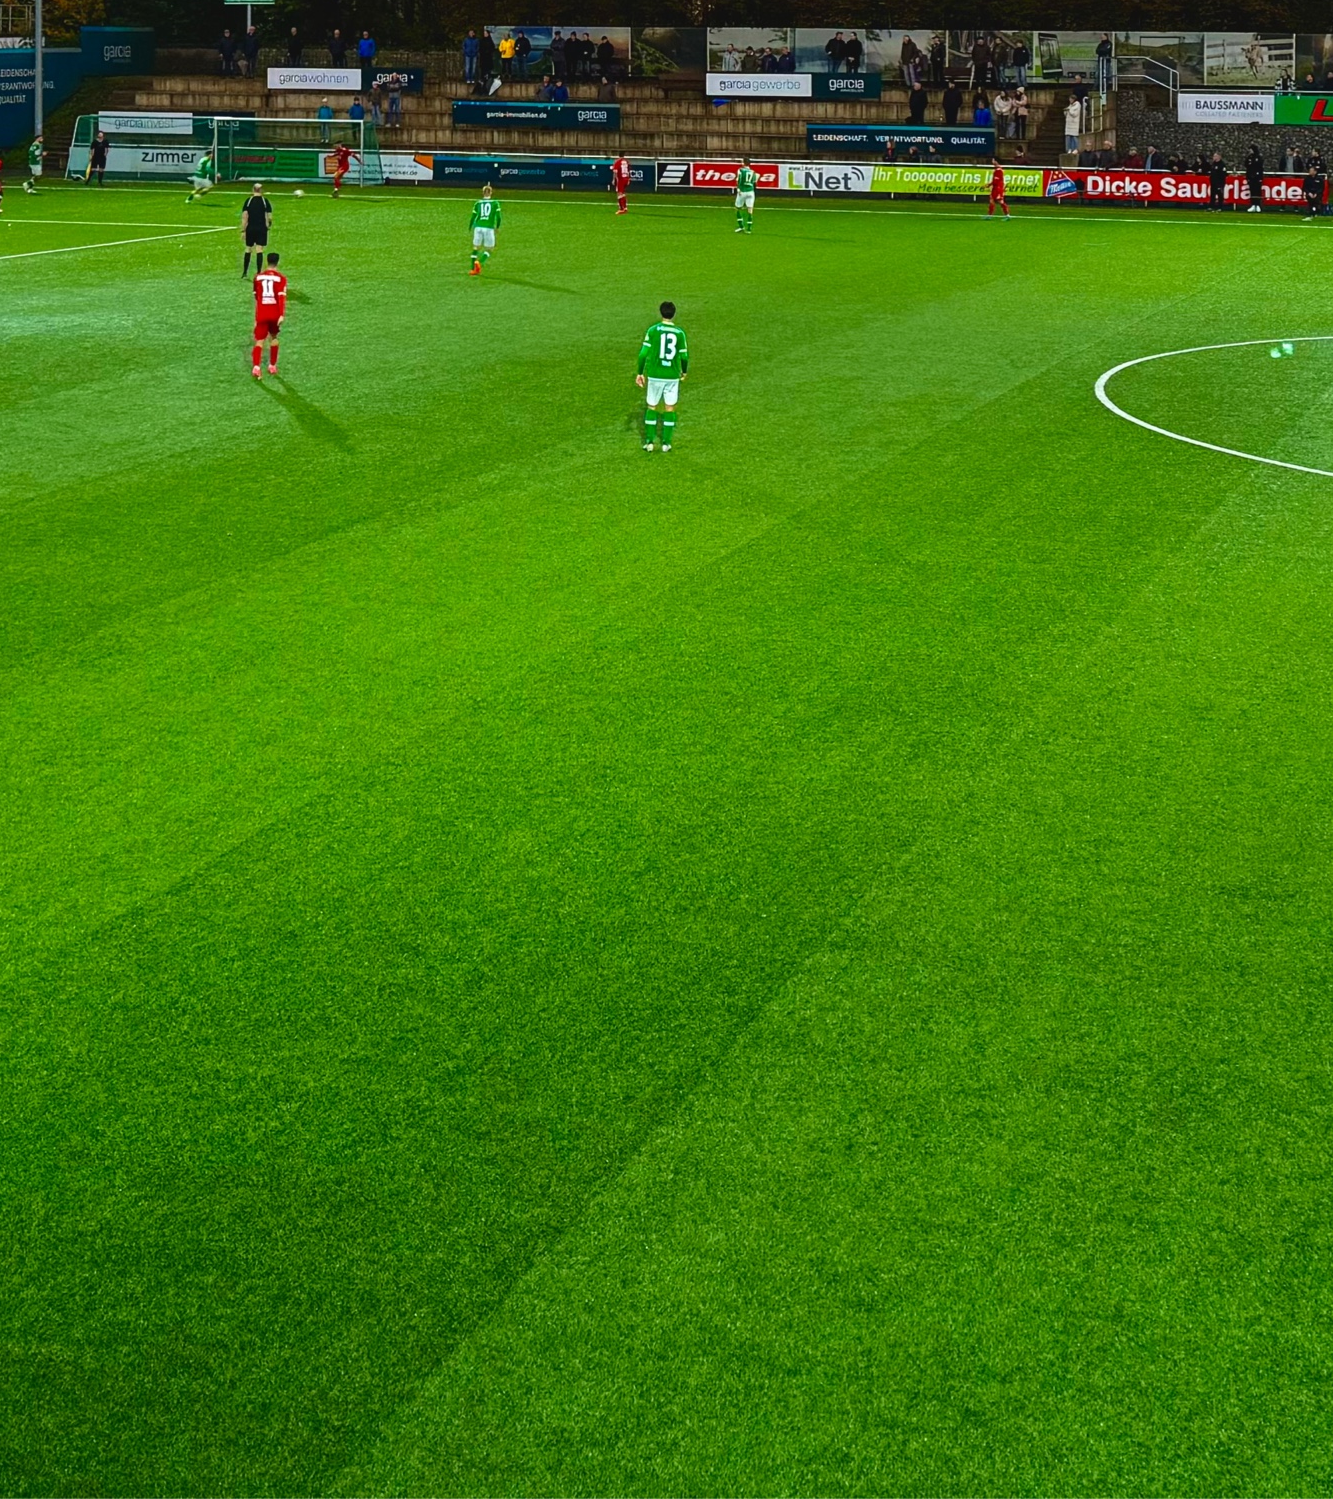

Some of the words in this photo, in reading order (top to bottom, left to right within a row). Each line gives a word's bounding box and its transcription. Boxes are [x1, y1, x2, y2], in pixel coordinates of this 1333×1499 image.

[829, 78, 864, 91] garcia
[1195, 100, 1264, 111] BAUSSMANN
[578, 110, 607, 121] garcia
[142, 152, 197, 164] zimmer
[787, 171, 851, 191] LNet
[874, 167, 892, 181] Ihr
[960, 169, 981, 184] ins
[1086, 175, 1153, 197] Dicke
[480, 202, 491, 217] 10
[659, 333, 677, 360] 13
